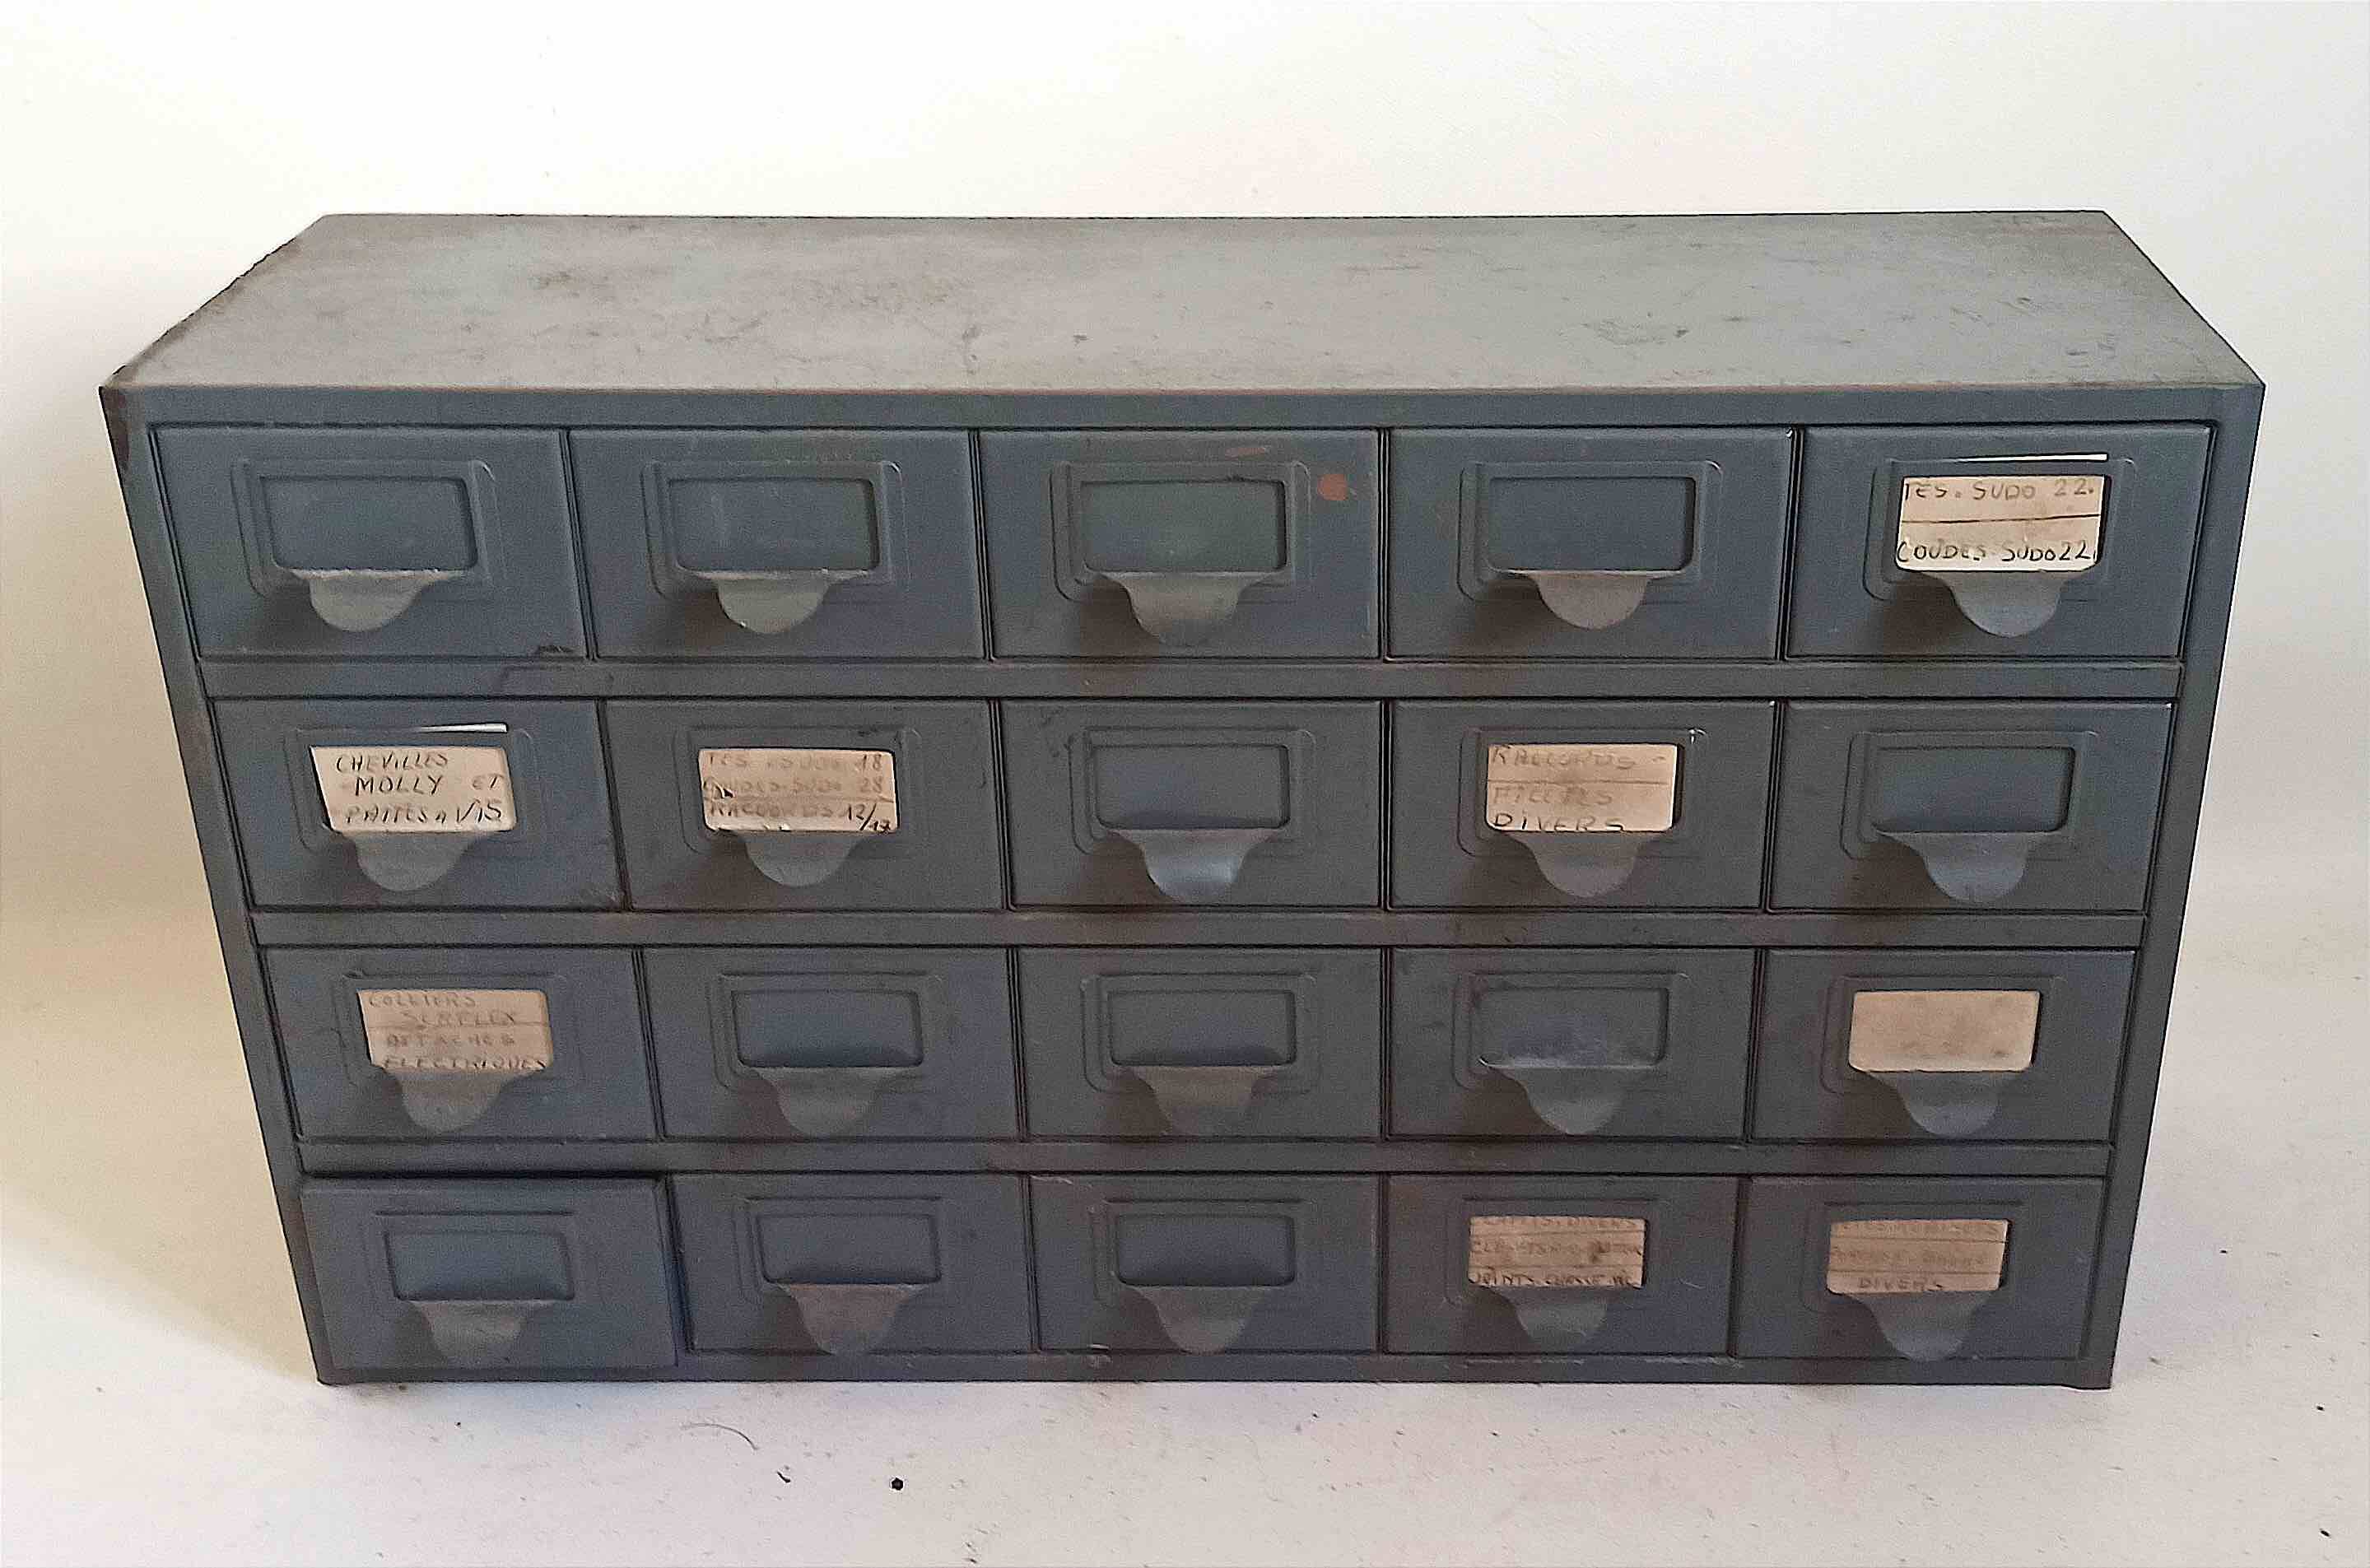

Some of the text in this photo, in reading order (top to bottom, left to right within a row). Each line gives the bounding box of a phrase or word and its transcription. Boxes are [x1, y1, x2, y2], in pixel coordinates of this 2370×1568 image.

[1972, 481, 2036, 500] SUDO
[356, 775, 443, 796] MOLLY
[456, 798, 503, 824] VIS
[1494, 808, 1624, 831] DIVERS
